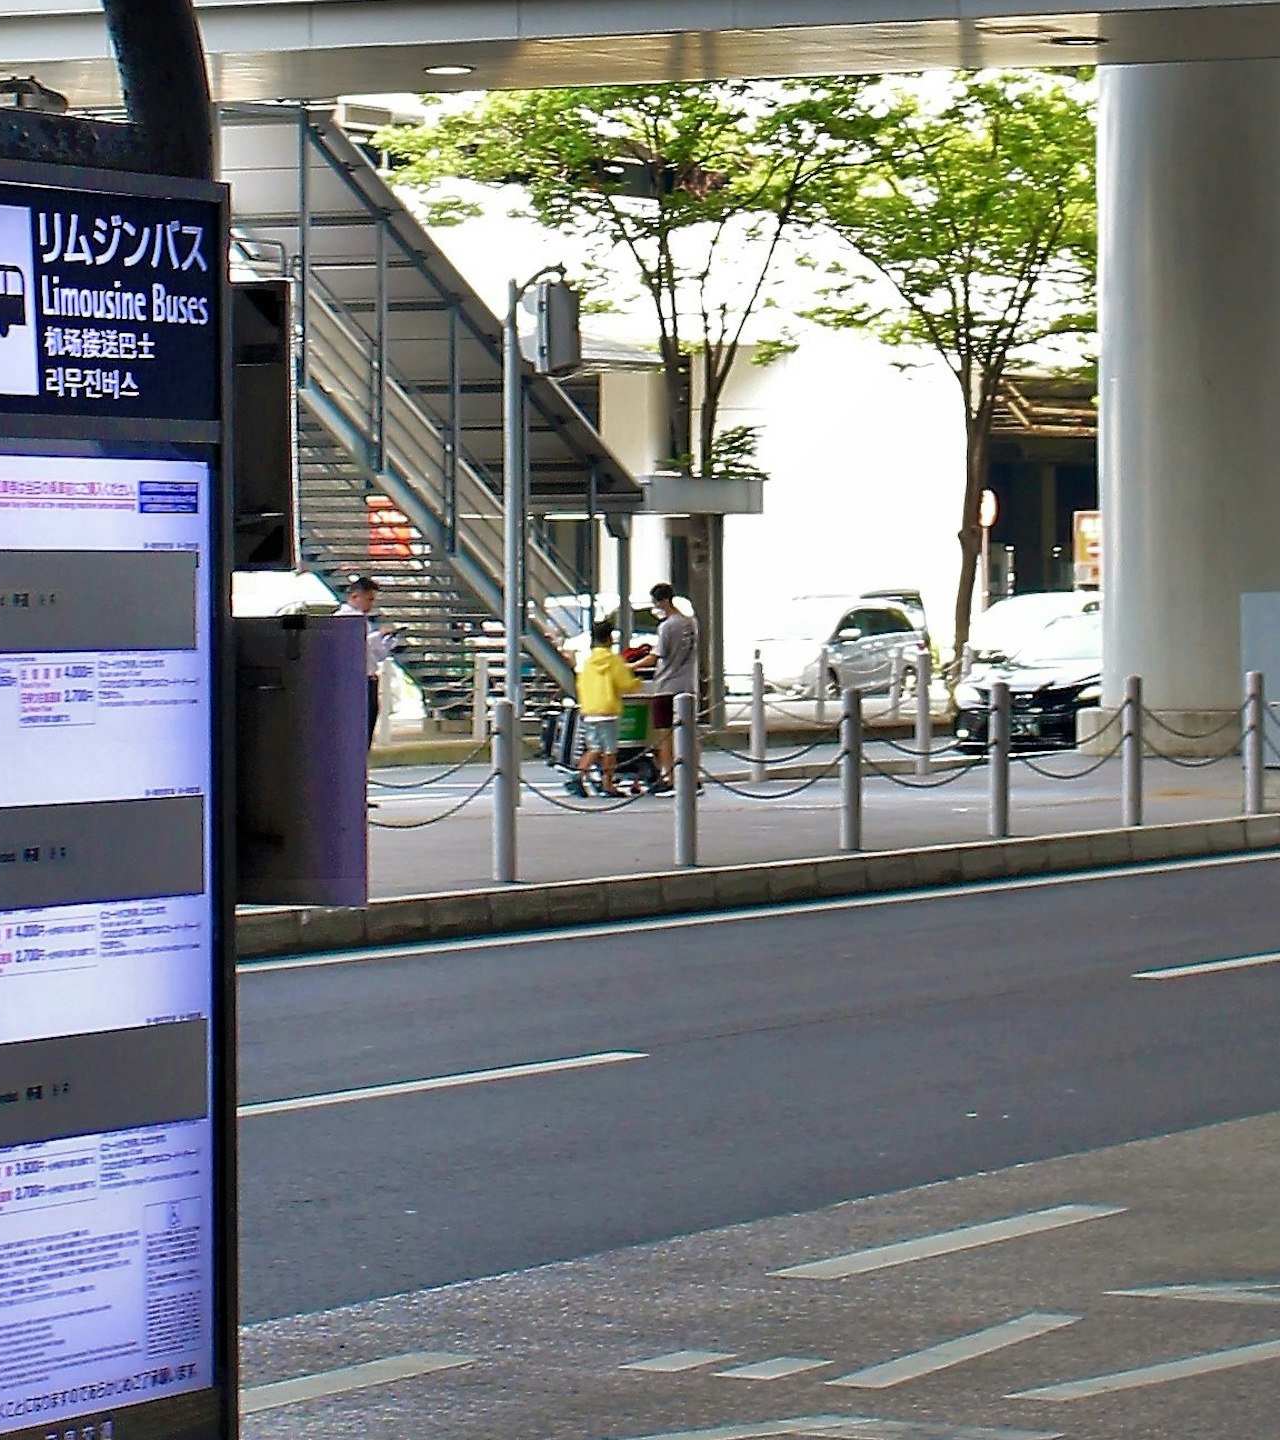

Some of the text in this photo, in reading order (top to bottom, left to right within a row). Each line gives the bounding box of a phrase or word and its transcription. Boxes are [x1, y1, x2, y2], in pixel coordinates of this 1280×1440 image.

[37, 211, 208, 273] リムジンバス
[41, 274, 208, 326] Limousine Buses
